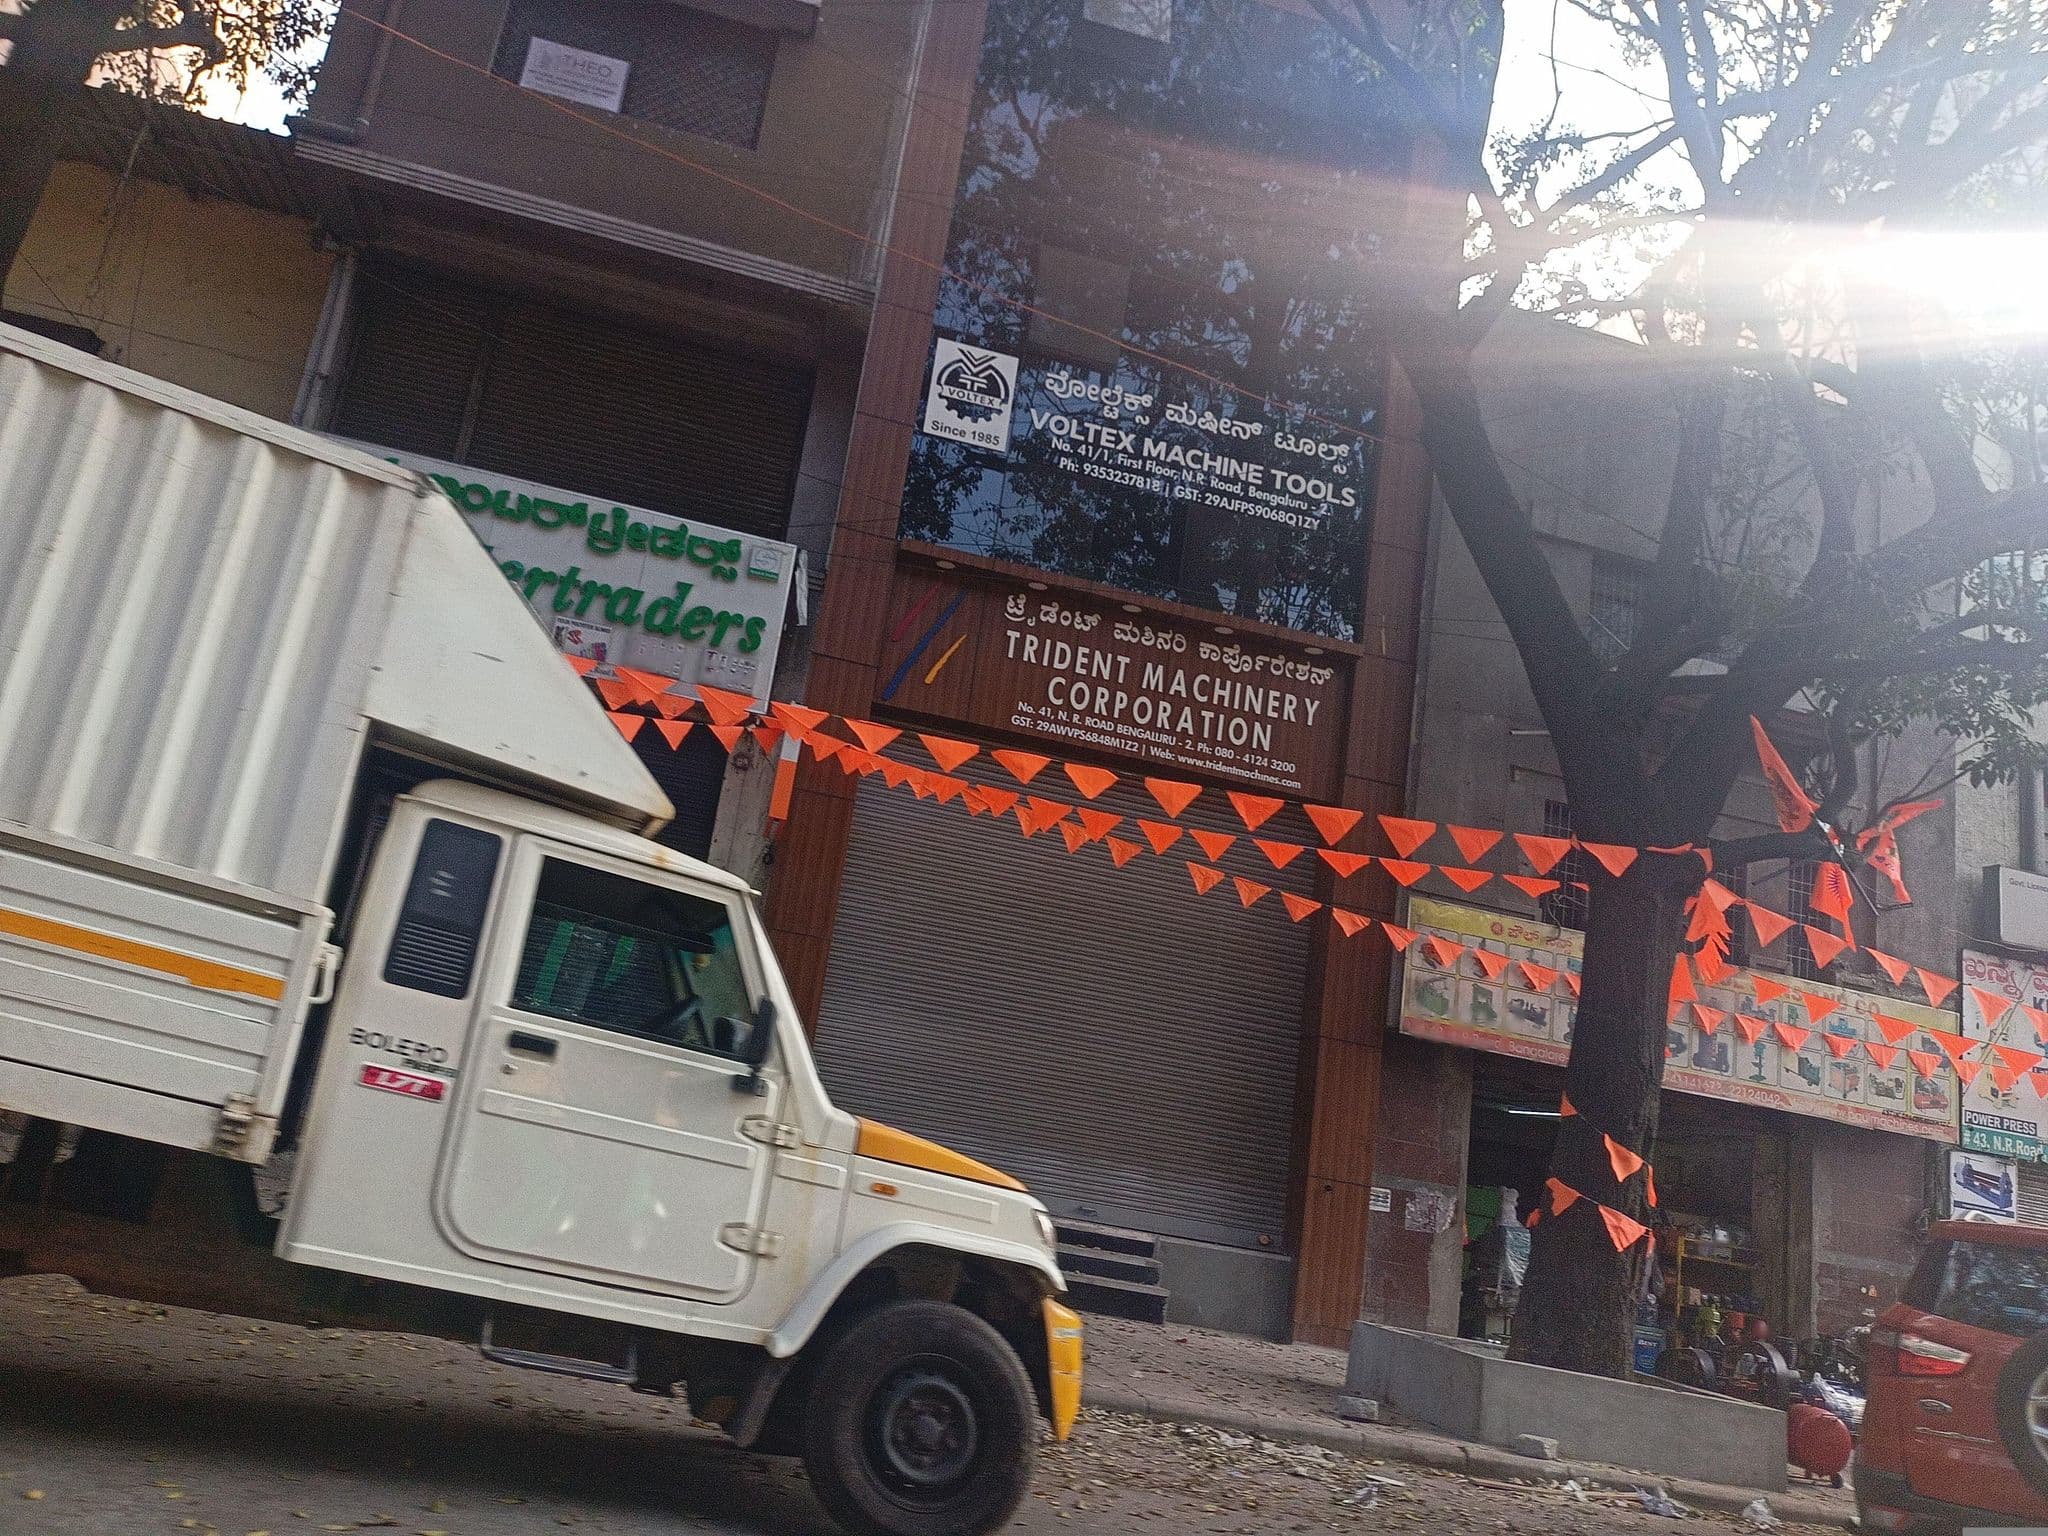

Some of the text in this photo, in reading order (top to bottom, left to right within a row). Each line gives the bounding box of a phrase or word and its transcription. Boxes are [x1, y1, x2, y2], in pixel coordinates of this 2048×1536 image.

[931, 420, 1000, 446] Since 1985
[948, 387, 995, 407] VOLTEX
[1029, 407, 1356, 507] VOLTEX MACHINE TOOLS
[1051, 437, 1074, 453] No.
[1077, 445, 1113, 465] 41/1,
[1117, 453, 1142, 470] First
[1145, 459, 1178, 480] Floor,
[1210, 478, 1244, 497] Road,
[1248, 485, 1308, 510] Bengaluru
[1059, 457, 1079, 473] Ph:
[1083, 463, 1160, 492] 9353237818
[1175, 486, 1202, 502] GST:
[1006, 629, 1321, 727] TRIDENT MACHINERY
[1047, 676, 1273, 752] CORPORATION
[1011, 714, 1034, 729] GST:
[1150, 745, 1176, 761] Web:
[1177, 754, 1301, 789] www.tridentmachines.com
[1018, 701, 1036, 714] No.
[1039, 706, 1055, 720] 41,
[1085, 716, 1114, 732] ROAD
[1117, 724, 1176, 746] BENGALURU
[1197, 742, 1212, 754] Ph:
[1214, 746, 1234, 760] 080
[1243, 753, 1268, 767] 4124
[1270, 759, 1296, 773] 3200
[349, 1027, 449, 1063] BOLERO
[1965, 1111, 2001, 1129] POWER
[2003, 1118, 2036, 1135] PRESS
